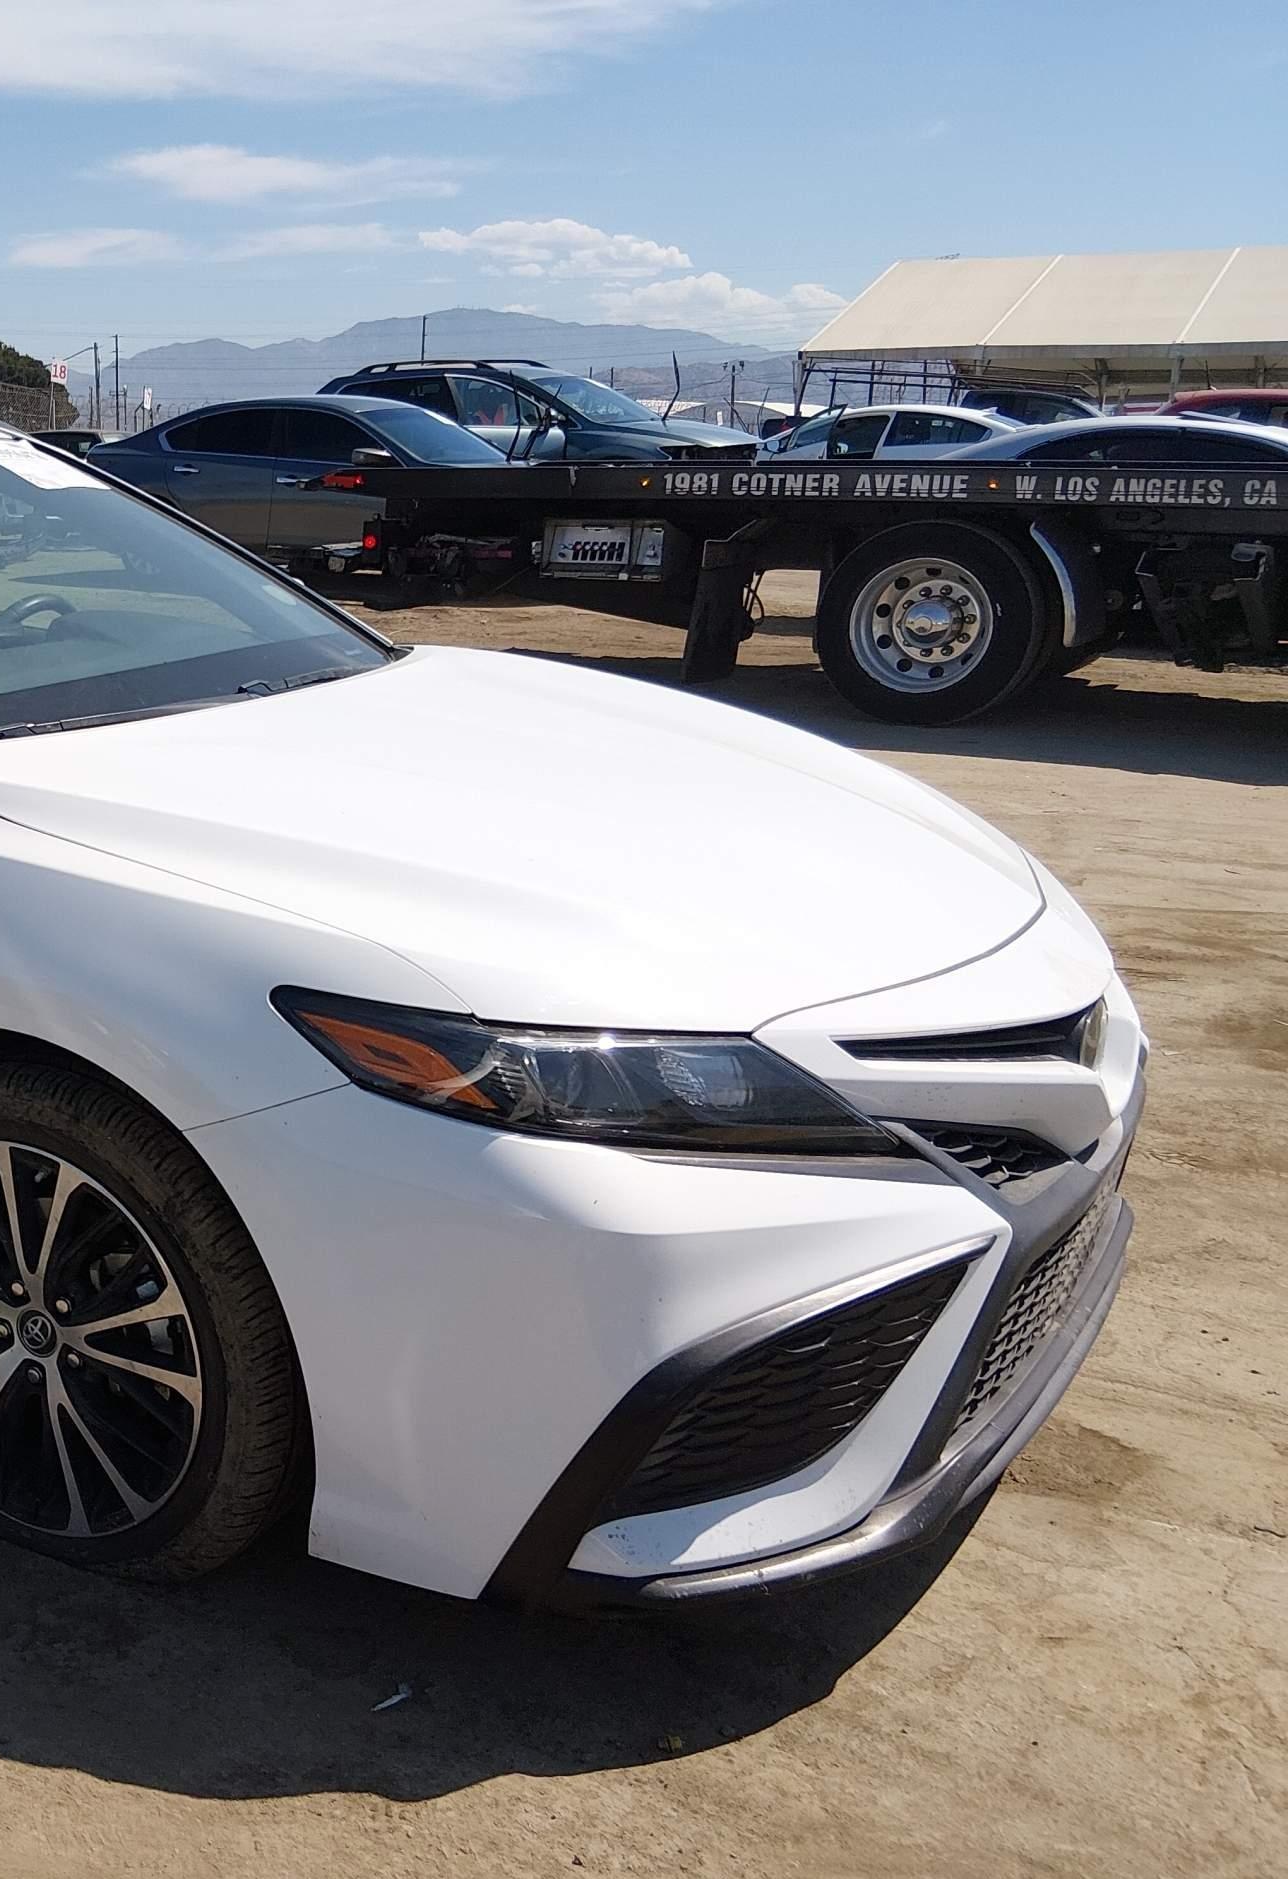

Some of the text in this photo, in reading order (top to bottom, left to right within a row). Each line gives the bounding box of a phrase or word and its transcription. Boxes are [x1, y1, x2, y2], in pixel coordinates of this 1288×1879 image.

[52, 364, 67, 379] 18
[663, 472, 969, 498] 1981 COTNER AVENUE
[1015, 475, 1278, 508] W. LOS ANGELES, CA
